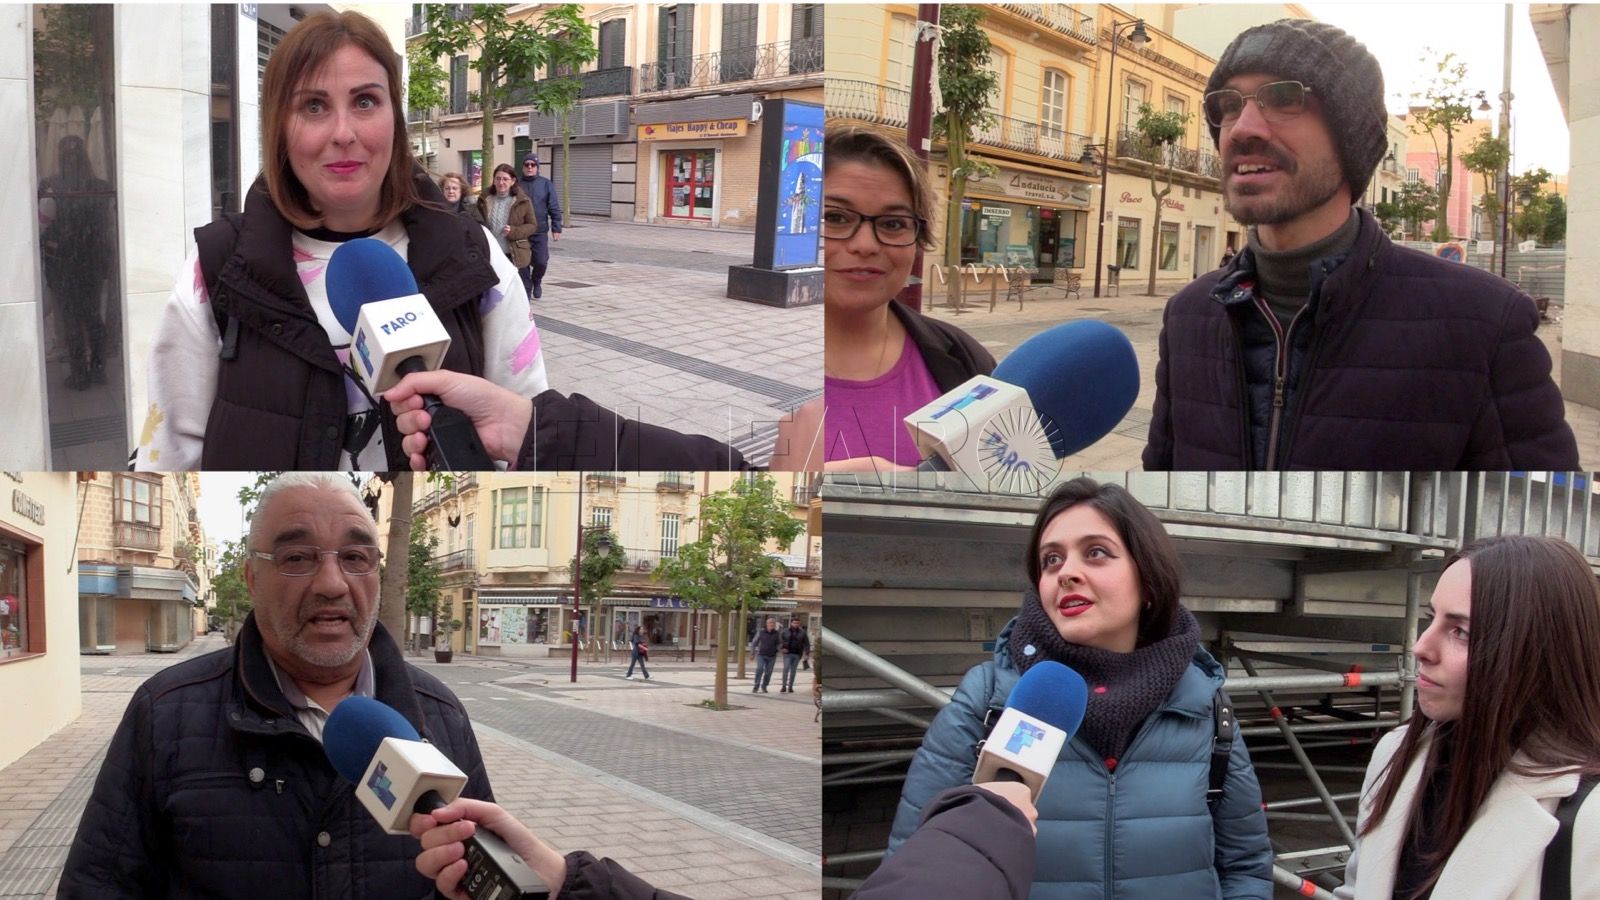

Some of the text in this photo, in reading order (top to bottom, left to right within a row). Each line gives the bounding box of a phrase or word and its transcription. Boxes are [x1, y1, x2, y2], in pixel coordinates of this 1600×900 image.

[667, 124, 684, 134] Viajes
[688, 123, 708, 132] Happy
[717, 121, 738, 131] Cheap
[1120, 191, 1142, 204] Paco
[656, 598, 674, 608] LA
